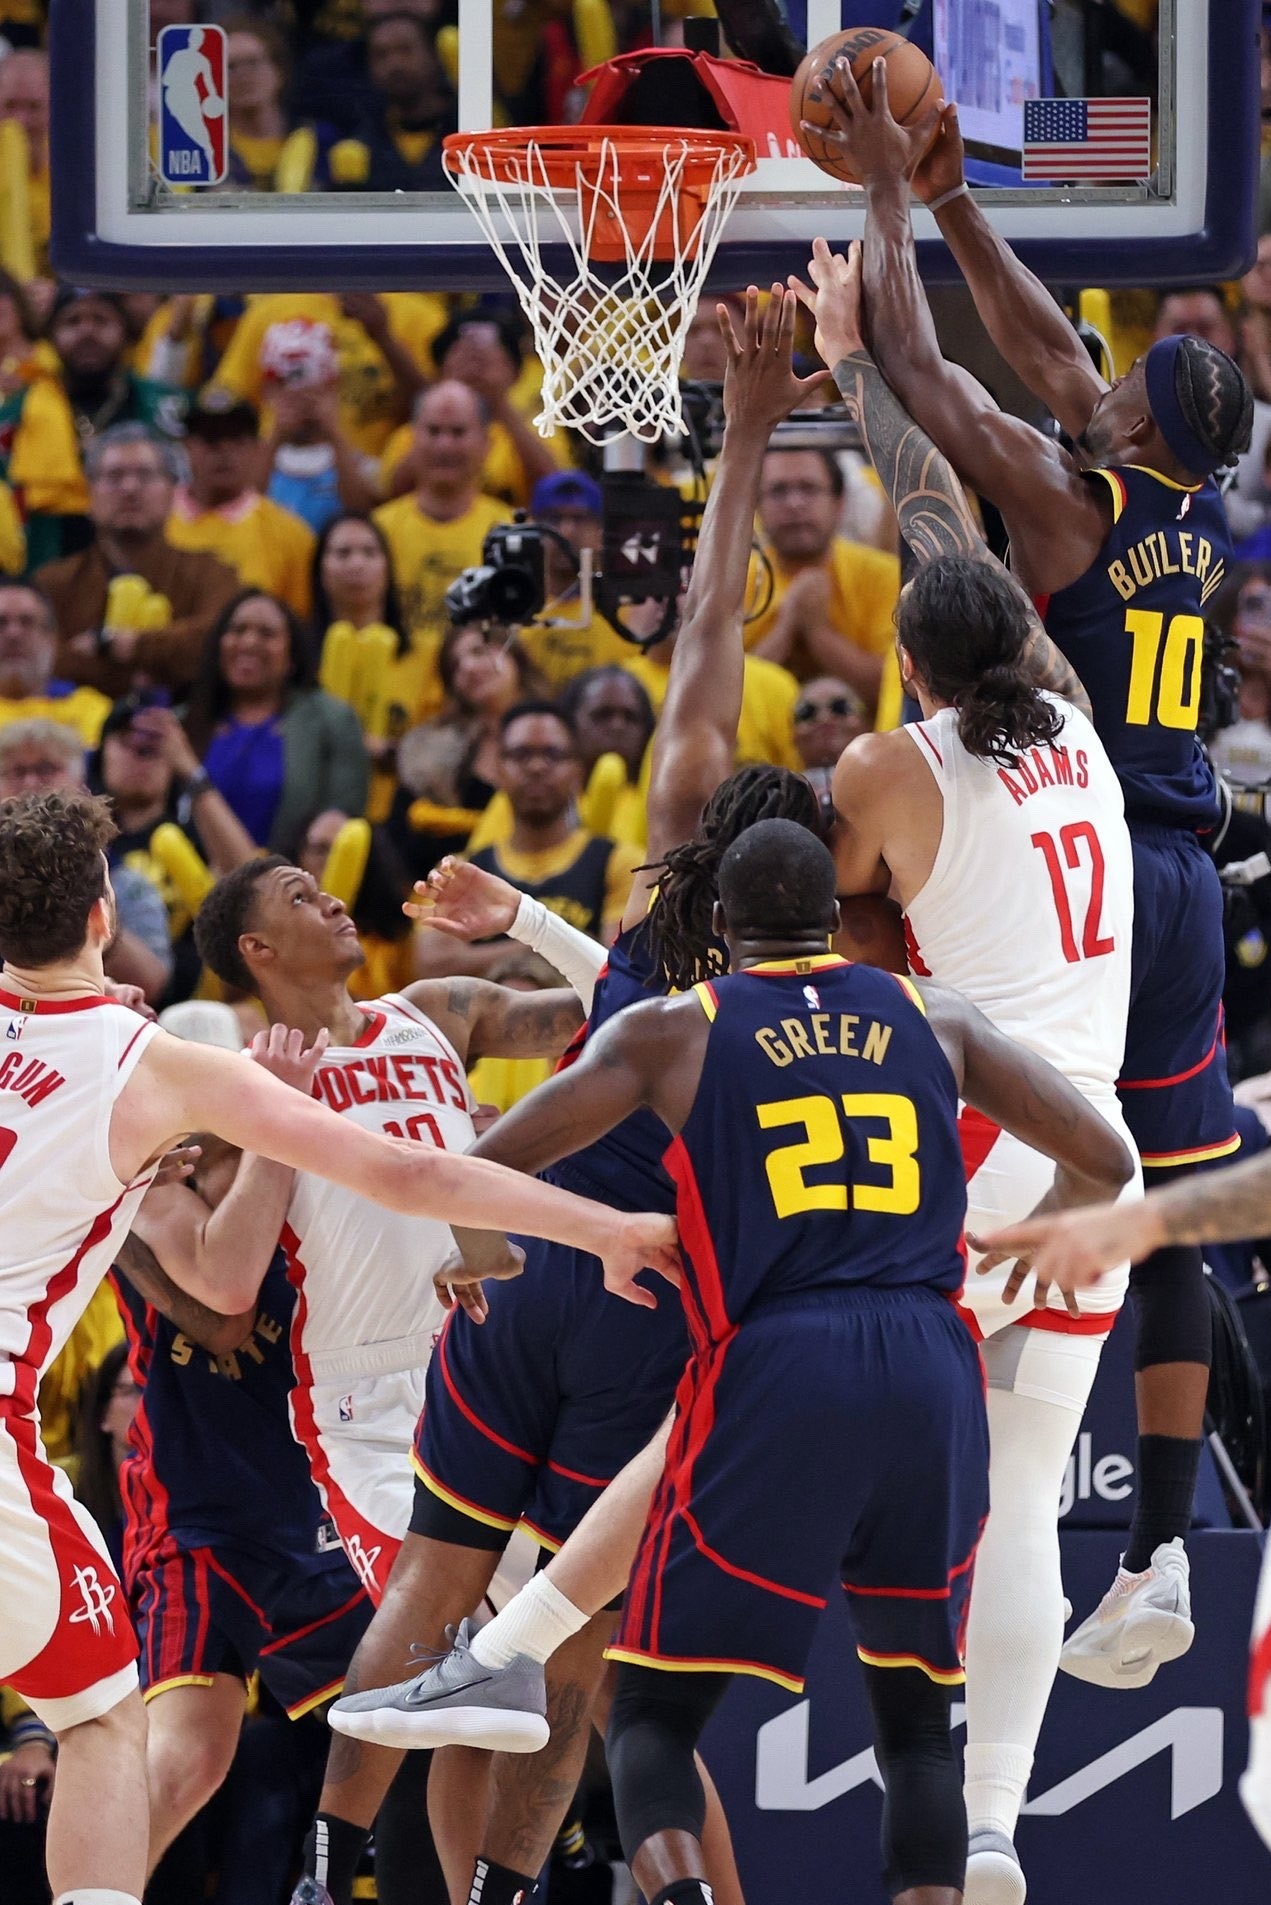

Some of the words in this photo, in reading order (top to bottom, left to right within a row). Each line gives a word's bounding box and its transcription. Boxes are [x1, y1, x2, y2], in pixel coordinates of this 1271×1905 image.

[169, 150, 202, 174] NBA
[1107, 531, 1212, 600] BUTLER
[1124, 608, 1204, 730] 10
[997, 746, 1088, 806] ADAMS
[1030, 820, 1115, 963] 12
[754, 1013, 893, 1067] GREEN
[756, 1093, 920, 1219] 23
[170, 1313, 282, 1380] SATE
